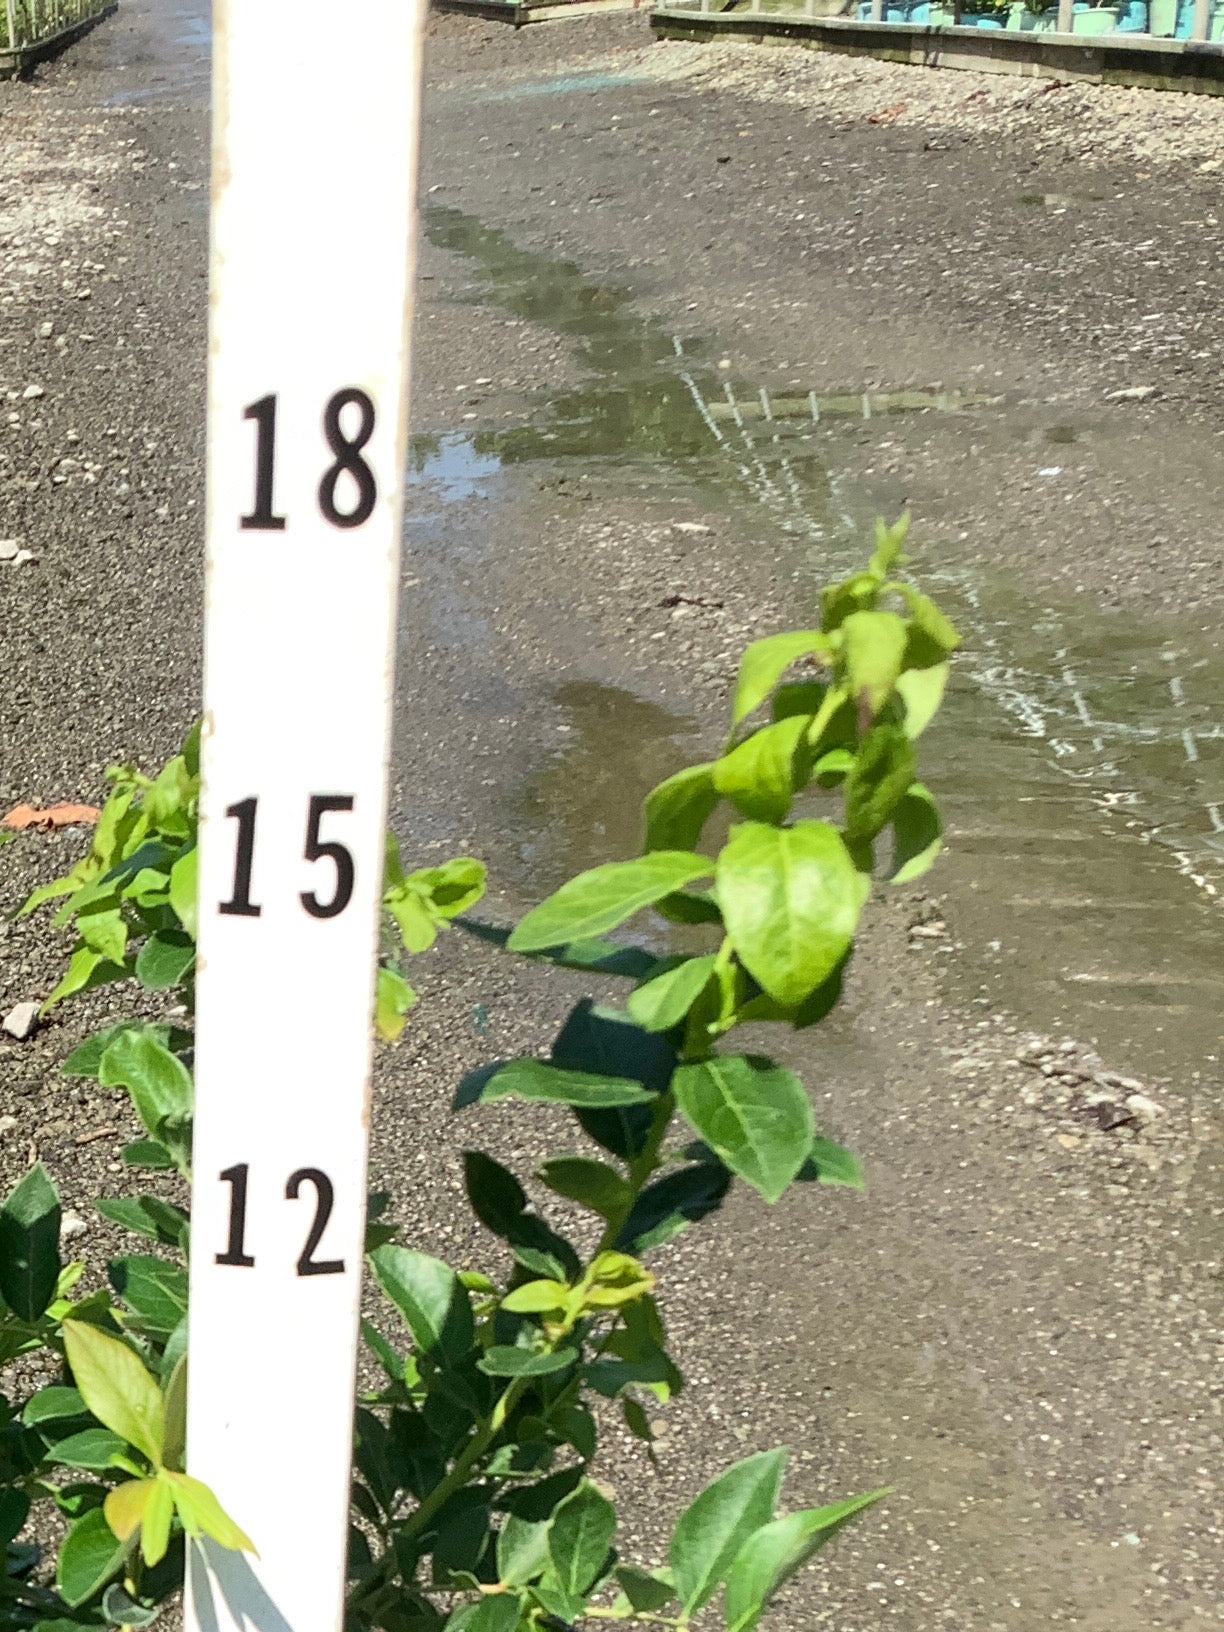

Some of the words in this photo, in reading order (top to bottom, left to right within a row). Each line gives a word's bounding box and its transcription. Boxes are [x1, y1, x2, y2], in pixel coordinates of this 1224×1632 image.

[238, 387, 379, 531] 18
[218, 794, 356, 920] 15
[214, 1162, 346, 1278] 12
